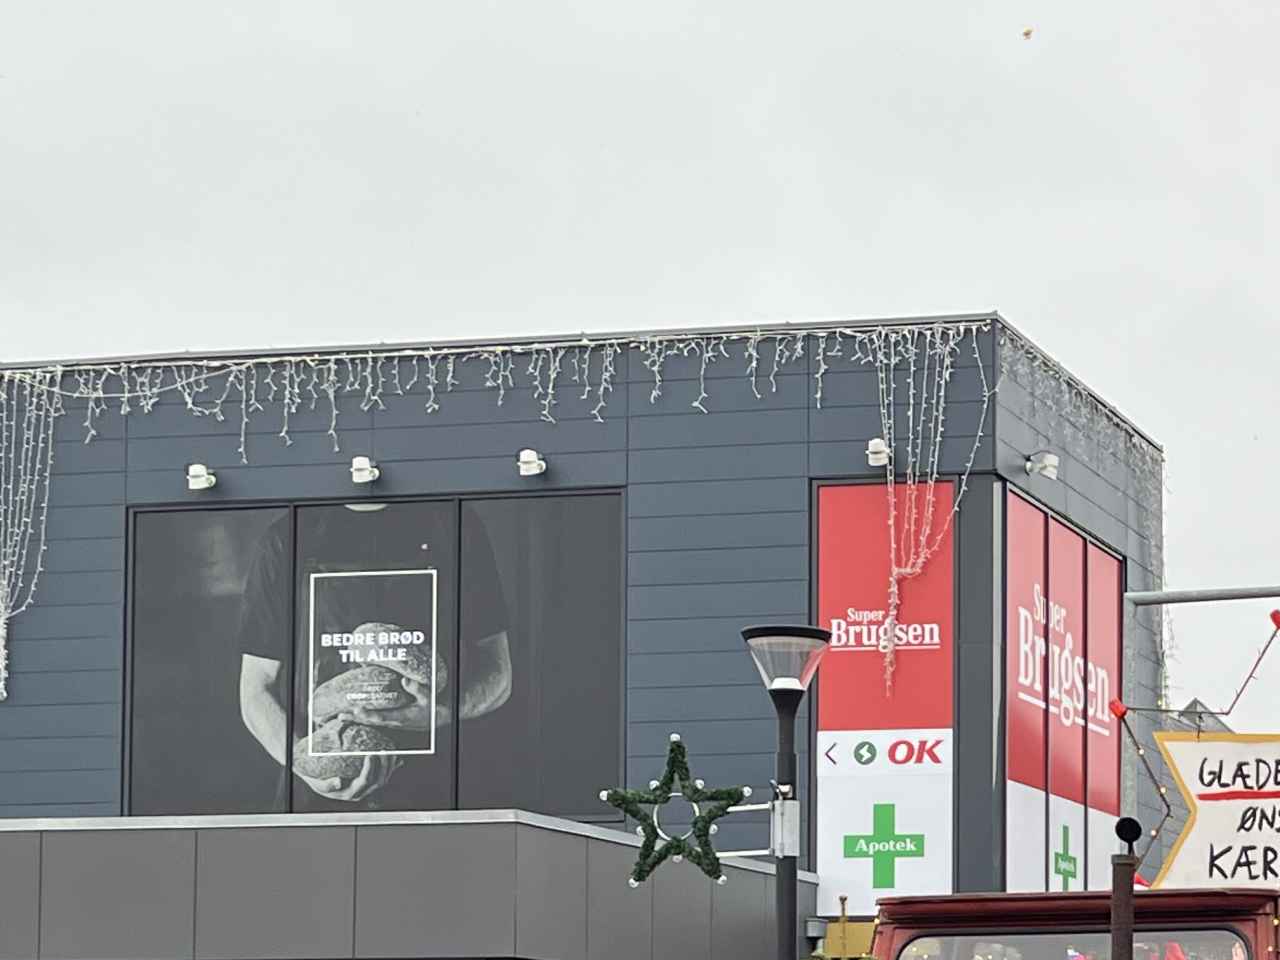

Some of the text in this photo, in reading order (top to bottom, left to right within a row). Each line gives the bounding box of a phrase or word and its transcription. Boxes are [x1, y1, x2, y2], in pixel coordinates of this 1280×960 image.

[847, 607, 885, 624] Super
[321, 631, 425, 648] BEDRE BRØD
[830, 617, 941, 653] Brugsen
[339, 648, 407, 663] TIL ALLE
[1018, 606, 1110, 727] Brugsen
[887, 739, 944, 765] OK
[855, 838, 917, 855] Apotek
